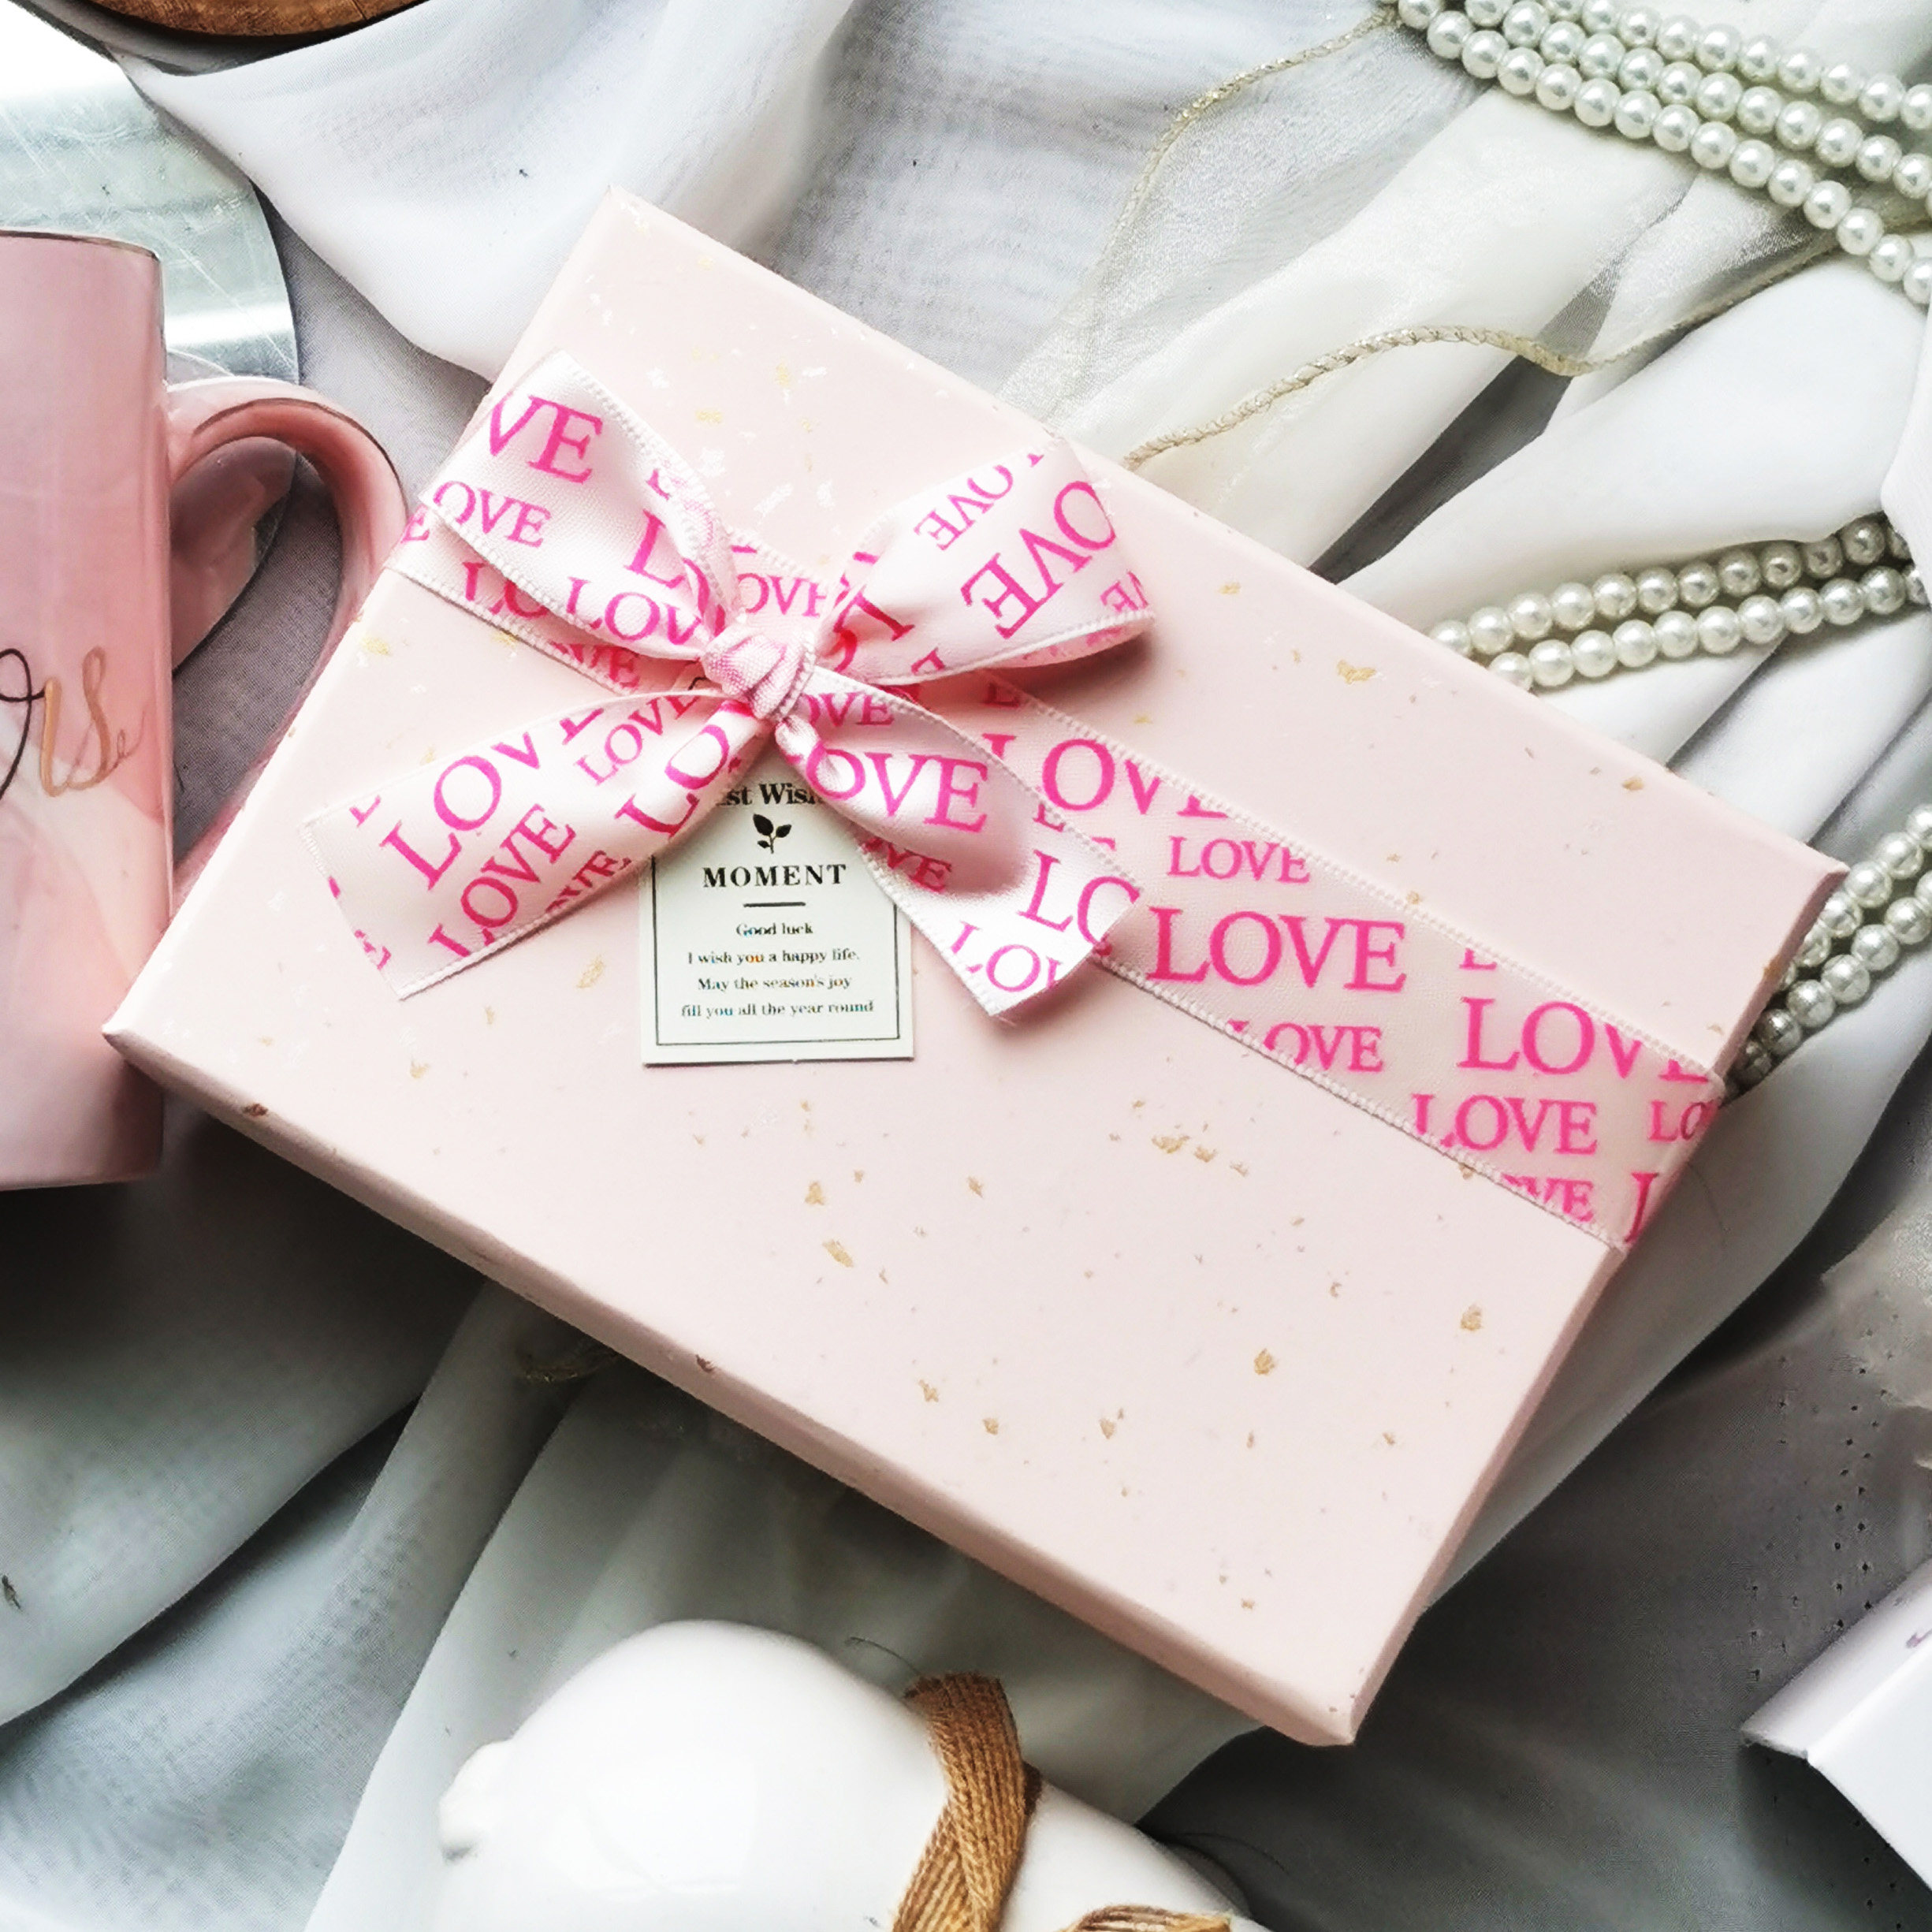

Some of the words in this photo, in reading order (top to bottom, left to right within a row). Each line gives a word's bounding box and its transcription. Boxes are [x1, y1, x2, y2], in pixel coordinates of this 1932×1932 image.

[433, 480, 552, 548] OVE
[914, 460, 1029, 551] OVE
[961, 481, 1116, 639] OVE
[716, 786, 752, 806] st
[806, 739, 988, 833] OVE
[703, 864, 846, 888] MOMENT
[1167, 836, 1310, 884] LOVE
[736, 923, 776, 936] Good
[782, 922, 813, 935] luck
[1146, 906, 1406, 992] LOVE
[698, 950, 732, 963] wish
[736, 952, 765, 966] you
[769, 954, 776, 962] a
[782, 950, 827, 964] happy
[832, 947, 860, 961] life.
[698, 978, 729, 992] May
[734, 977, 759, 989] the
[762, 974, 824, 988] season's
[827, 974, 852, 989] joy
[681, 1004, 702, 1017] fill
[706, 1007, 733, 1019] you
[739, 1003, 757, 1016] all
[761, 1003, 785, 1015] the
[790, 1003, 824, 1015] year
[828, 1000, 875, 1013] round
[1245, 1021, 1383, 1072] OVE
